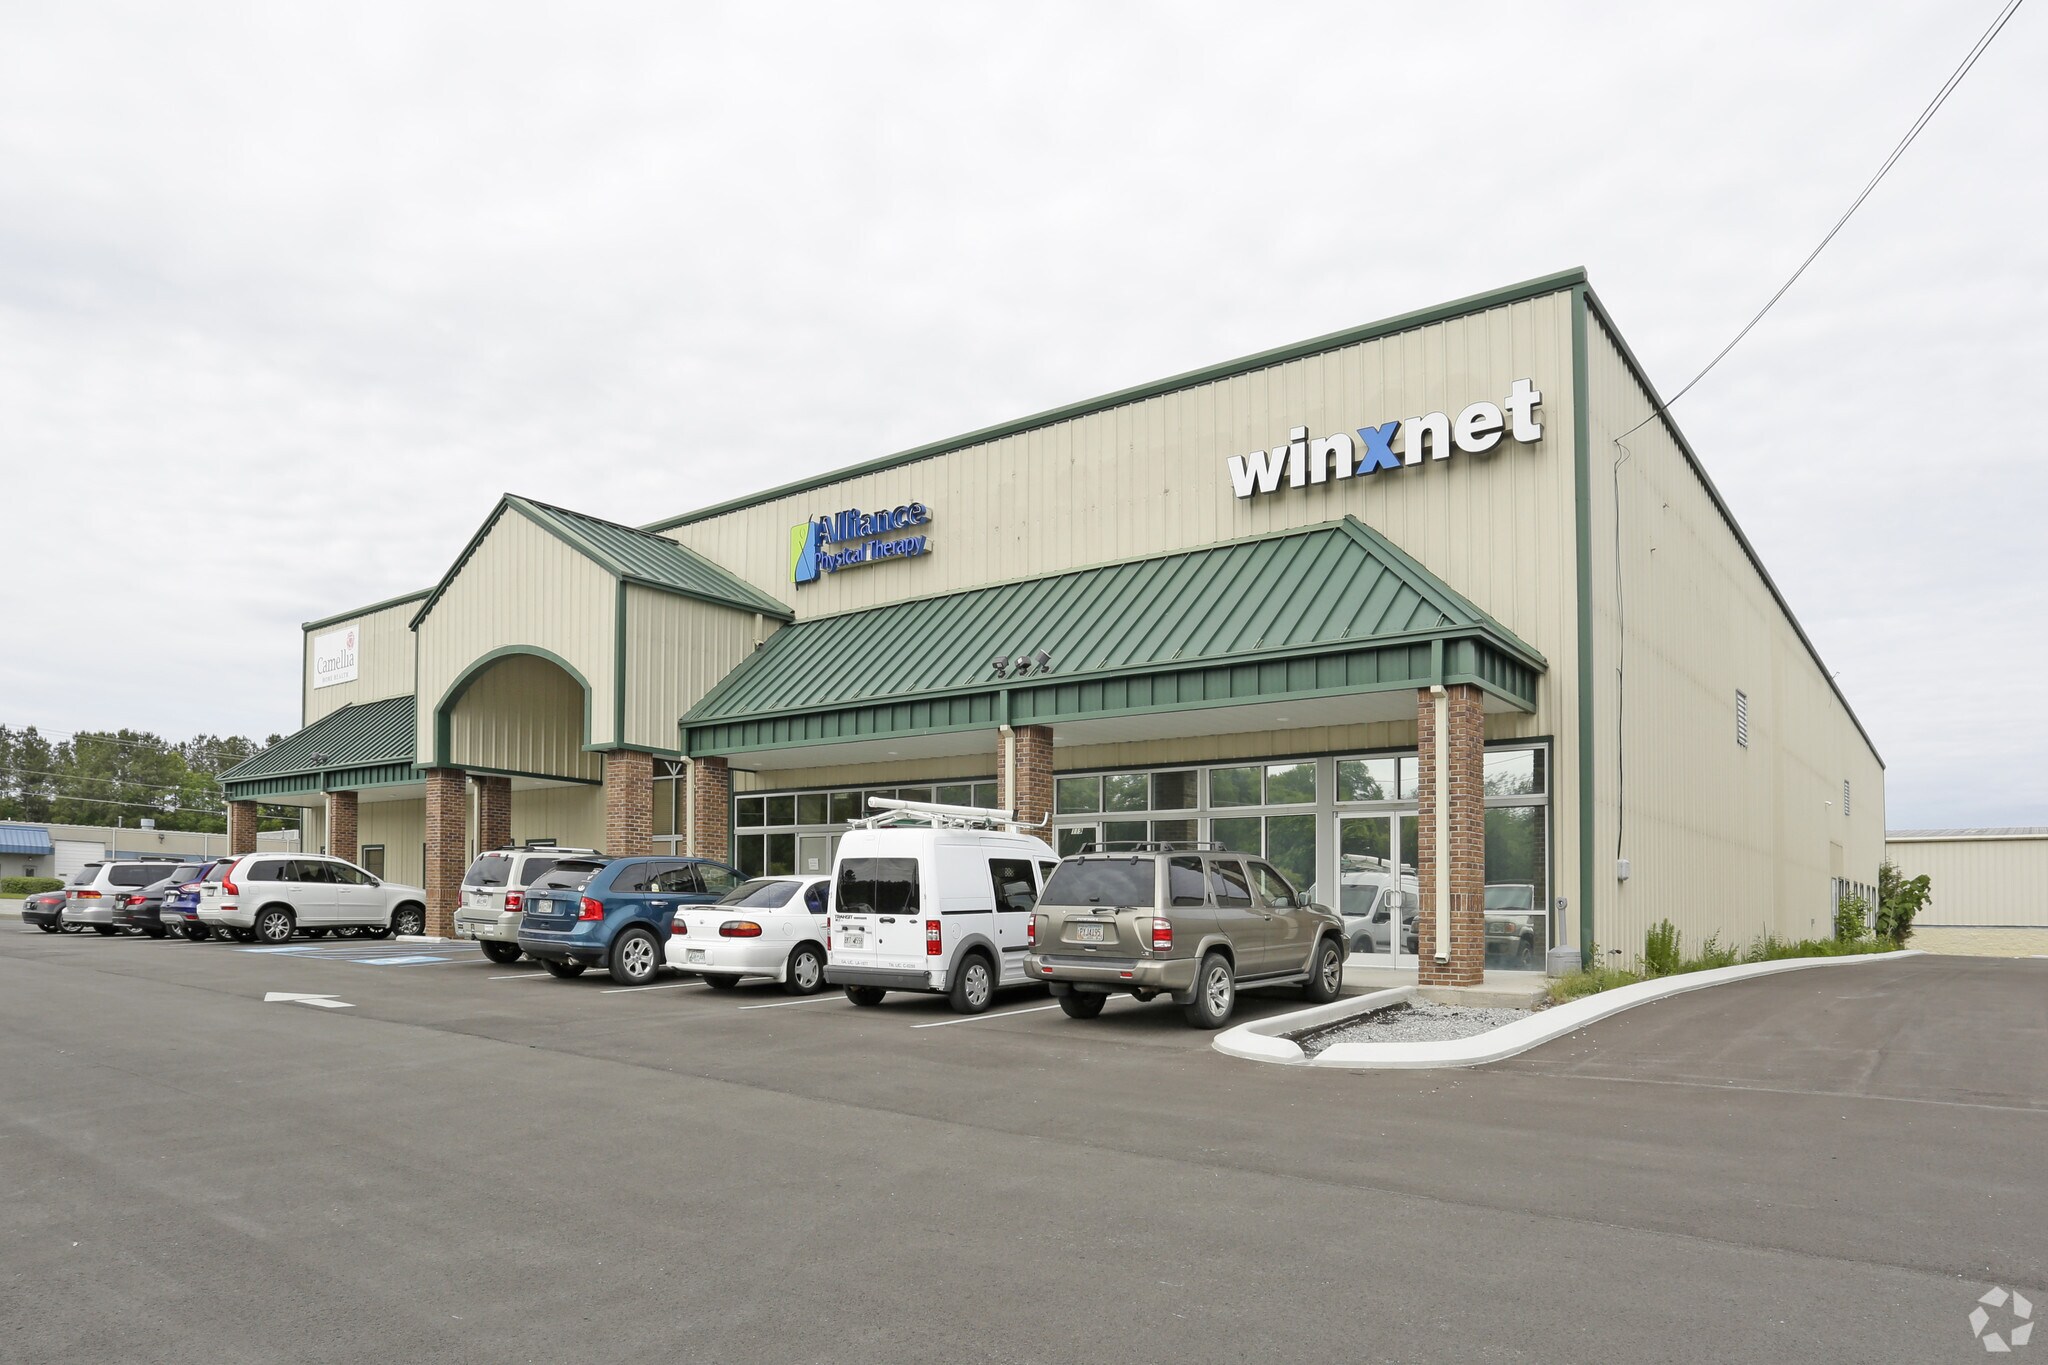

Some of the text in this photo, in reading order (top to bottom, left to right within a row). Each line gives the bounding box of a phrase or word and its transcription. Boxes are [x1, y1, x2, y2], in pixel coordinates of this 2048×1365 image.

[1226, 377, 1544, 499] winxnet
[817, 502, 927, 546] Alliance
[815, 535, 927, 574] Physical Therapy
[317, 649, 354, 674] Camellia
